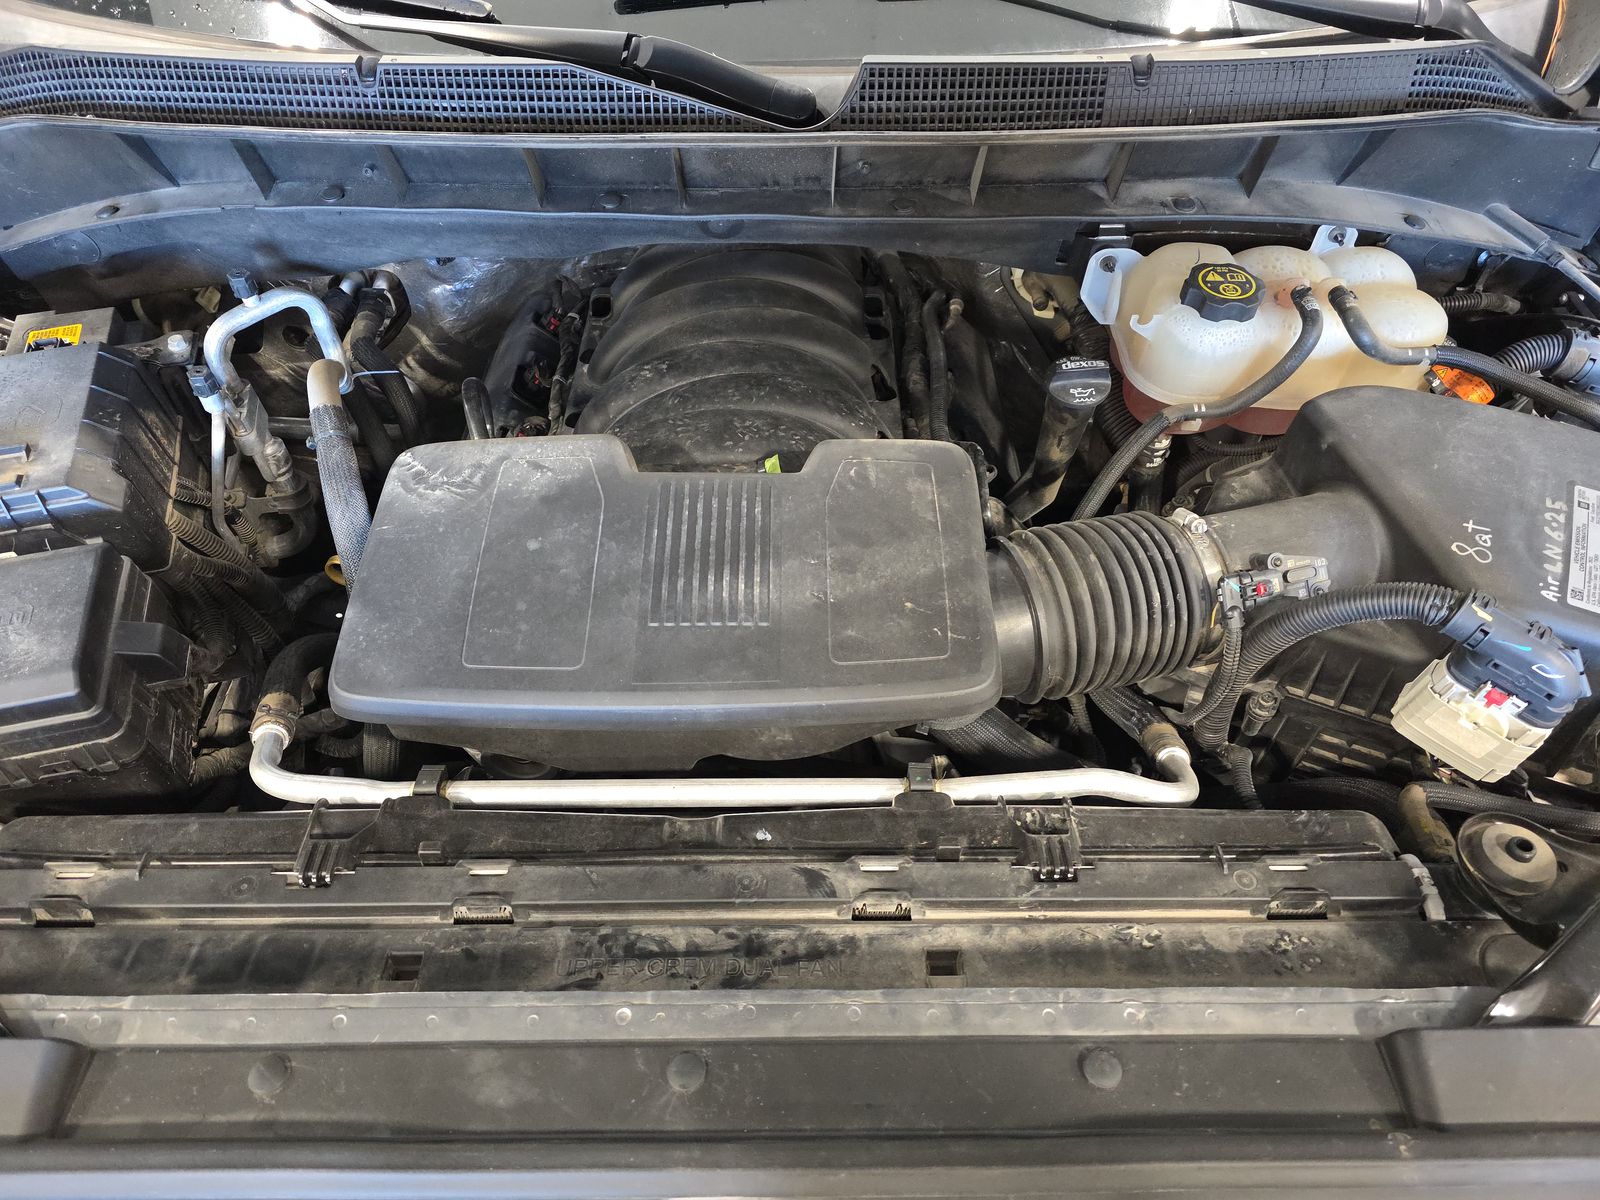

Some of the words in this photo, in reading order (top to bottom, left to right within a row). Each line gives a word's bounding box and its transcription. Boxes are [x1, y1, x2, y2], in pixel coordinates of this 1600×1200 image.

[1061, 360, 1105, 370] dexos
[1539, 575, 1562, 602] Air
[556, 957, 639, 977] UPPER
[724, 957, 789, 978] DUAL
[797, 958, 842, 977] FAN
